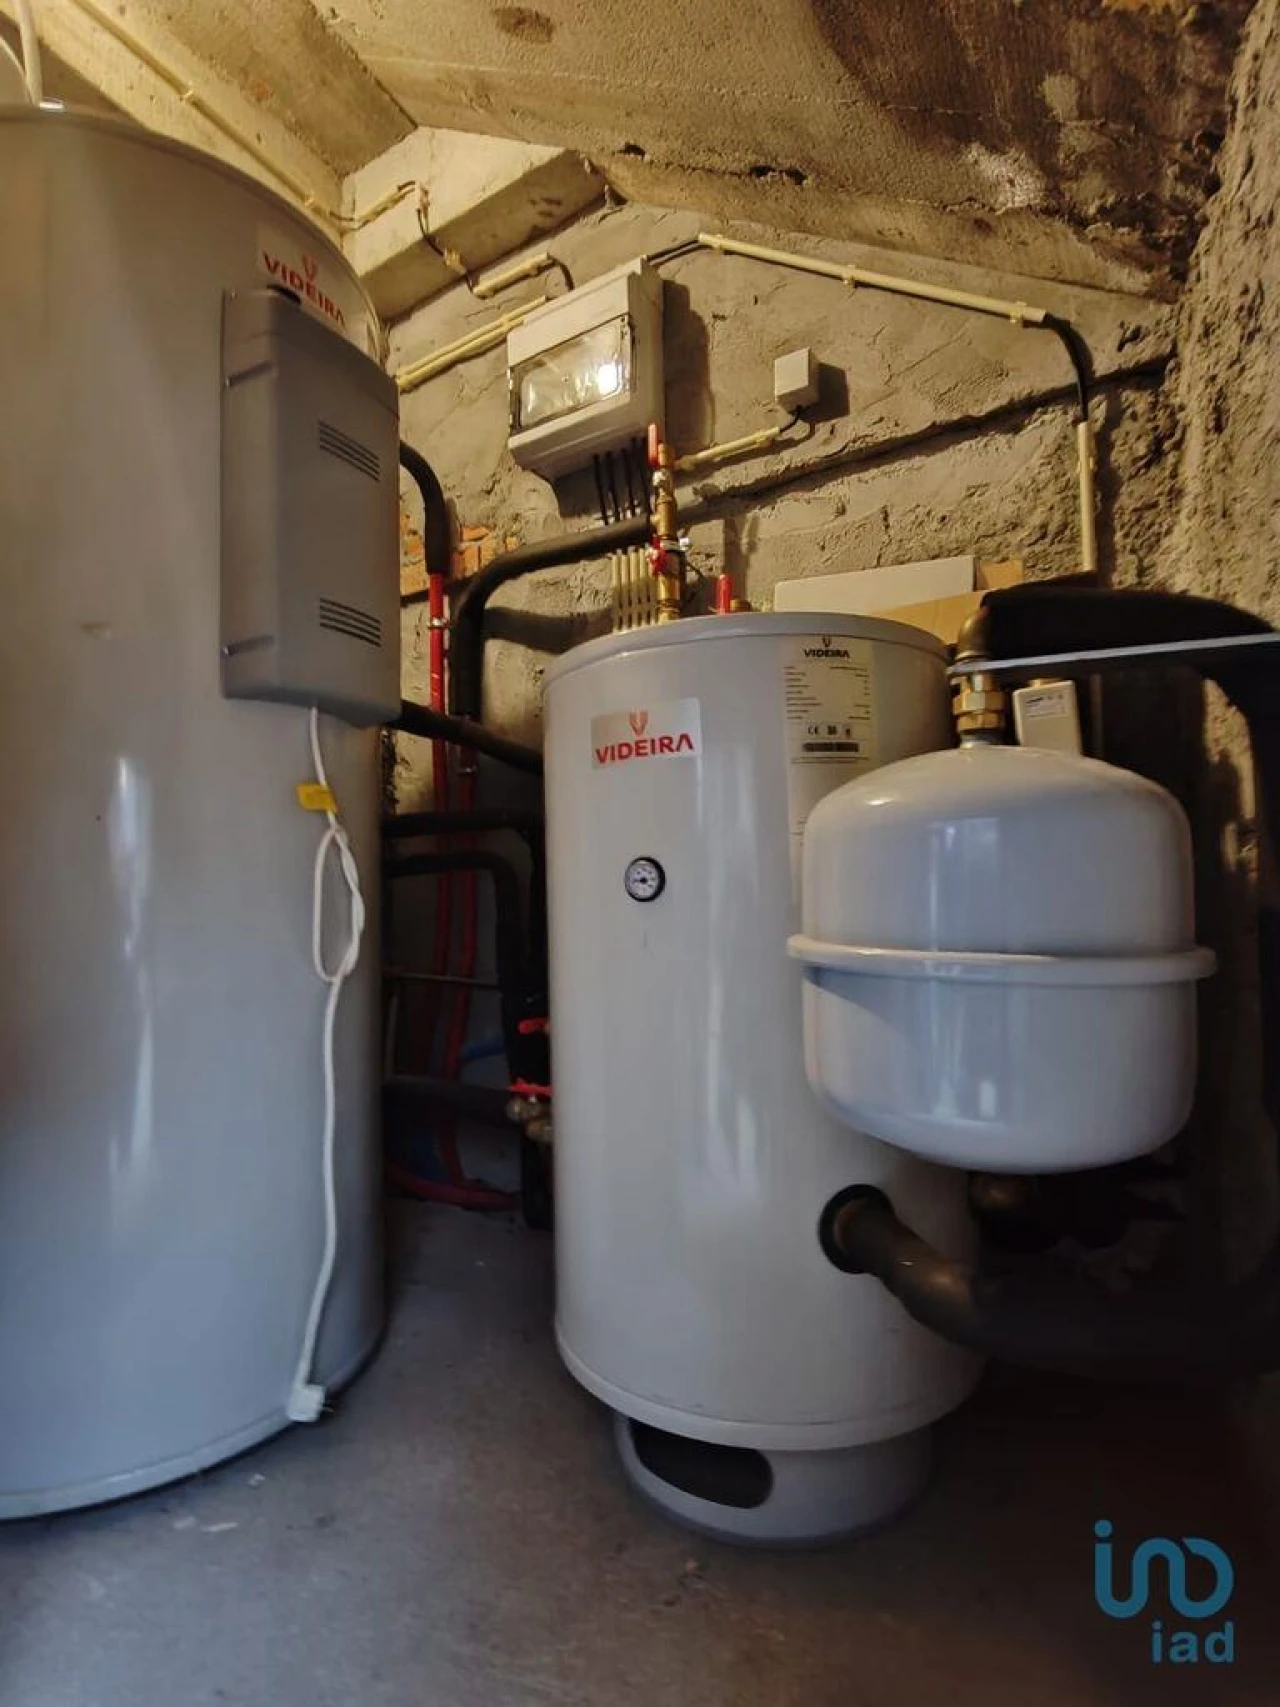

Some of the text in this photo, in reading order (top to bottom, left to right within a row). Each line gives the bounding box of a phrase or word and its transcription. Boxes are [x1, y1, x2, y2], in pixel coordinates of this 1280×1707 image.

[264, 252, 345, 328] VIDEIRA
[804, 649, 851, 658] VIDEIRA
[595, 733, 694, 763] VIDEIRA
